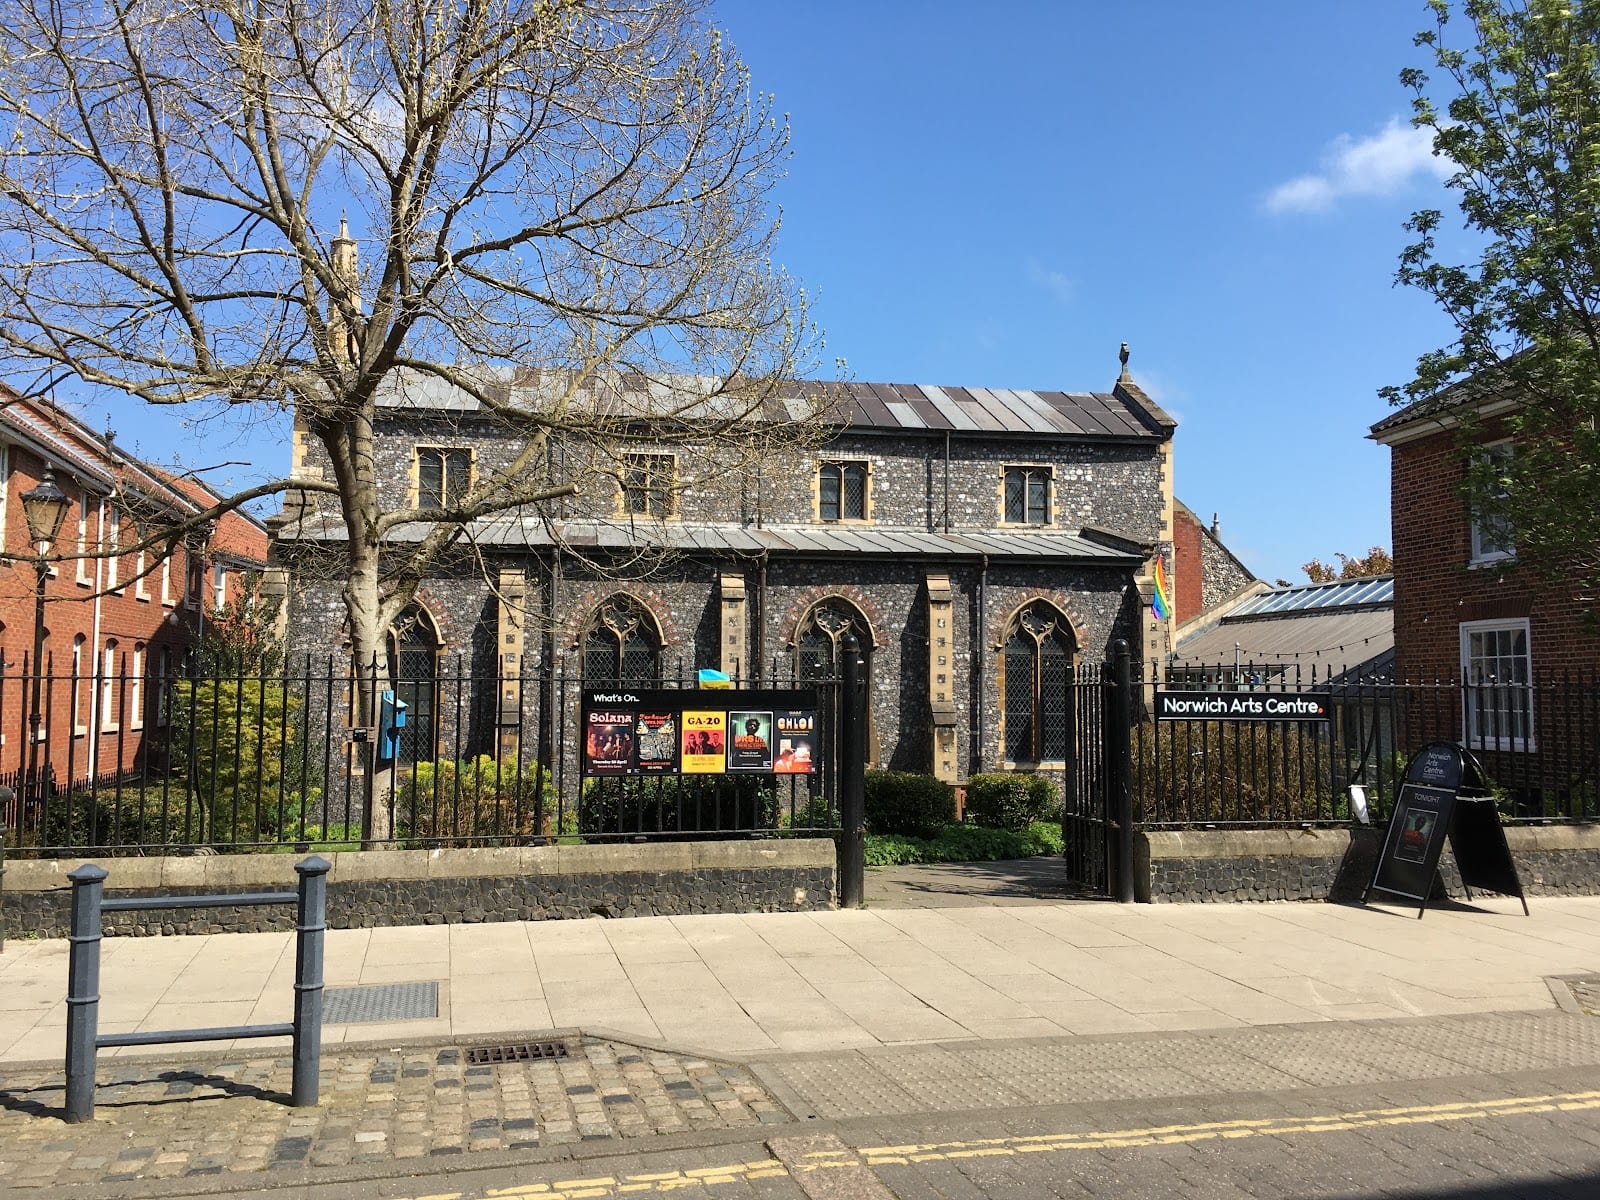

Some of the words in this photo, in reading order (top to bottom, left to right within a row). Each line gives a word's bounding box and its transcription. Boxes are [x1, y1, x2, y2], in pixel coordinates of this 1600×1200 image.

[593, 694, 622, 702] What's
[1164, 696, 1228, 713] Norwich
[1230, 696, 1263, 713] Arts
[589, 712, 633, 724] Solana
[687, 717, 721, 725] GA-20
[1428, 752, 1452, 760] Norwich
[1425, 759, 1439, 767] Arts
[1414, 792, 1440, 803] TONIGHT
